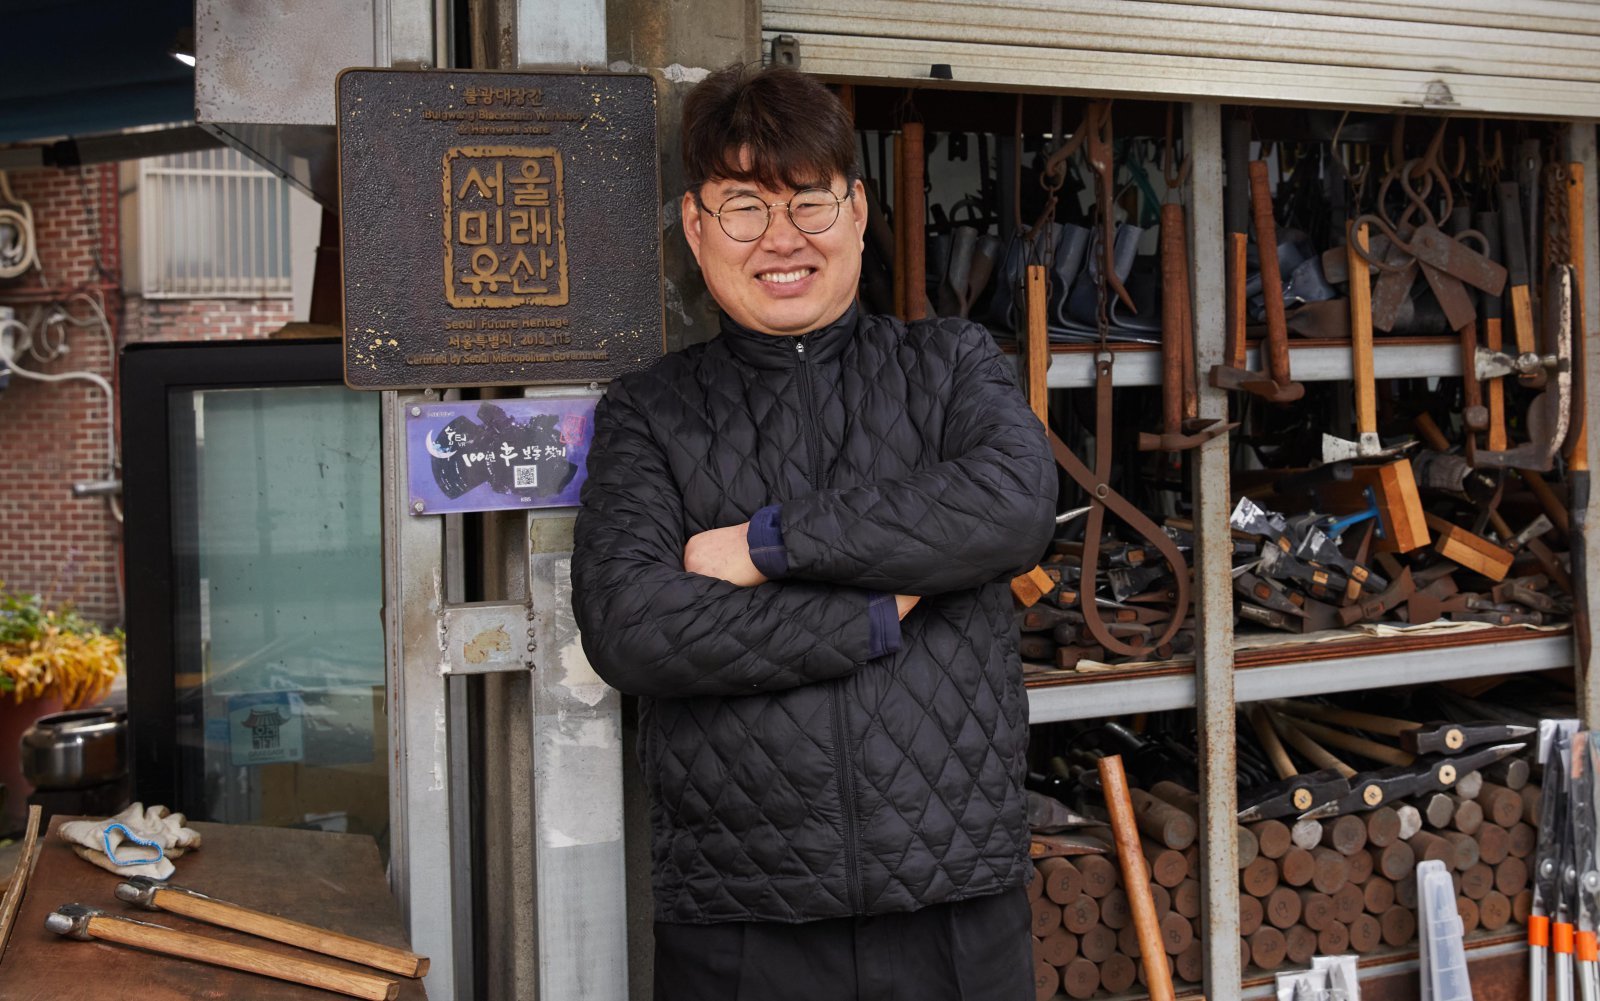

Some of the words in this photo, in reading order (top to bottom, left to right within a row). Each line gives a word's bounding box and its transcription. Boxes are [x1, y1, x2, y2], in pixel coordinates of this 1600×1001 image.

[463, 87, 544, 106] 불광대장간
[471, 124, 520, 135] Hardware
[522, 124, 551, 135] Store
[458, 160, 552, 206] 서울
[458, 207, 552, 245] 미래
[460, 245, 554, 294] 유산
[444, 319, 476, 330] Seoul
[481, 319, 519, 330] Future
[522, 317, 570, 329] Heritage
[406, 353, 448, 366] Certified
[450, 354, 462, 366] by
[463, 352, 489, 364] Seoul
[492, 351, 551, 364] Metropolitan
[552, 349, 609, 362] Government
[462, 450, 497, 468] 100년
[500, 441, 519, 467] 후
[544, 445, 567, 462] 찾기
